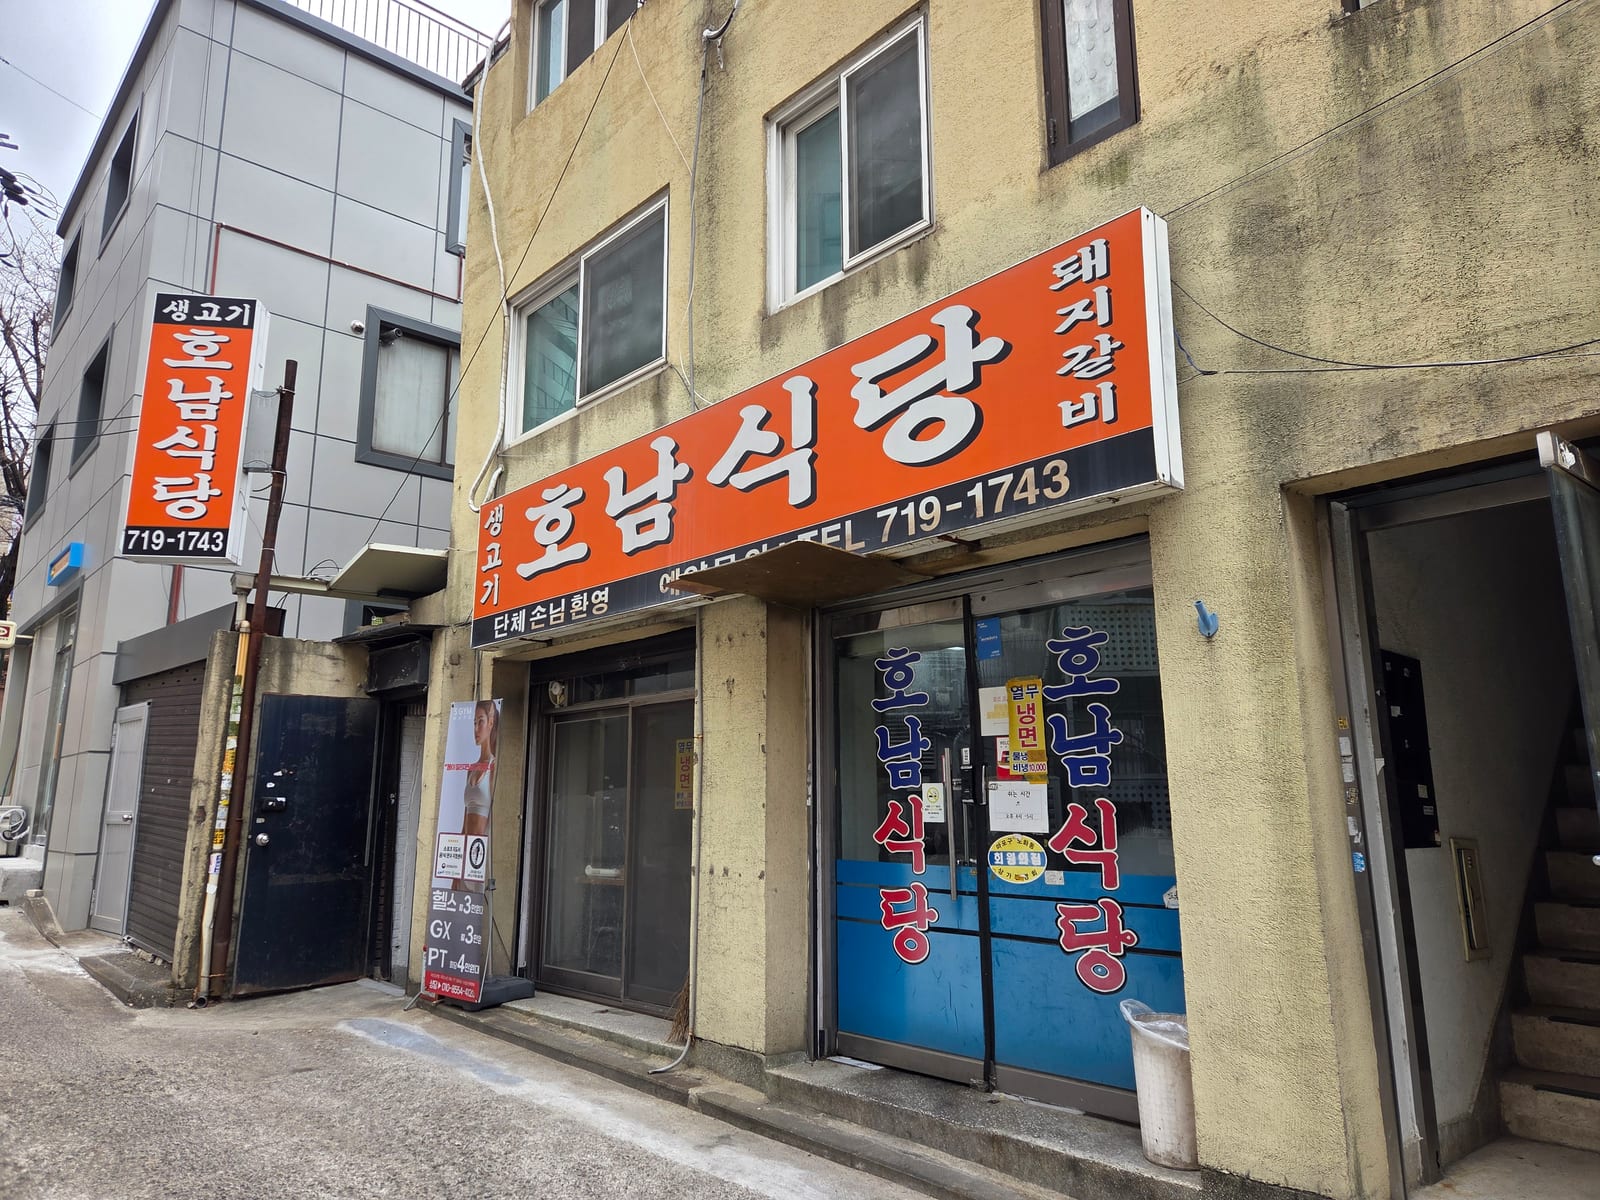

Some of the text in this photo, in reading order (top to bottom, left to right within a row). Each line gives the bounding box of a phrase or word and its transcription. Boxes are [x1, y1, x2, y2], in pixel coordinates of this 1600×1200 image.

[162, 299, 251, 326] 생고기
[1049, 238, 1125, 428] 돼지갈비
[152, 328, 234, 520] 호남식당
[516, 304, 1011, 581] 호남식당
[876, 459, 1071, 543] 719-1743
[127, 529, 225, 552] 719-1743
[480, 503, 504, 606] 생고기
[493, 586, 609, 639] 단체 손님 환영
[1010, 684, 1040, 701] 열무
[1016, 703, 1038, 748] 냉면
[871, 646, 939, 964] 호남식당
[1041, 625, 1138, 992] 호남식당
[432, 889, 457, 912] 헬스
[430, 919, 452, 941] GX
[427, 947, 448, 969] PT
